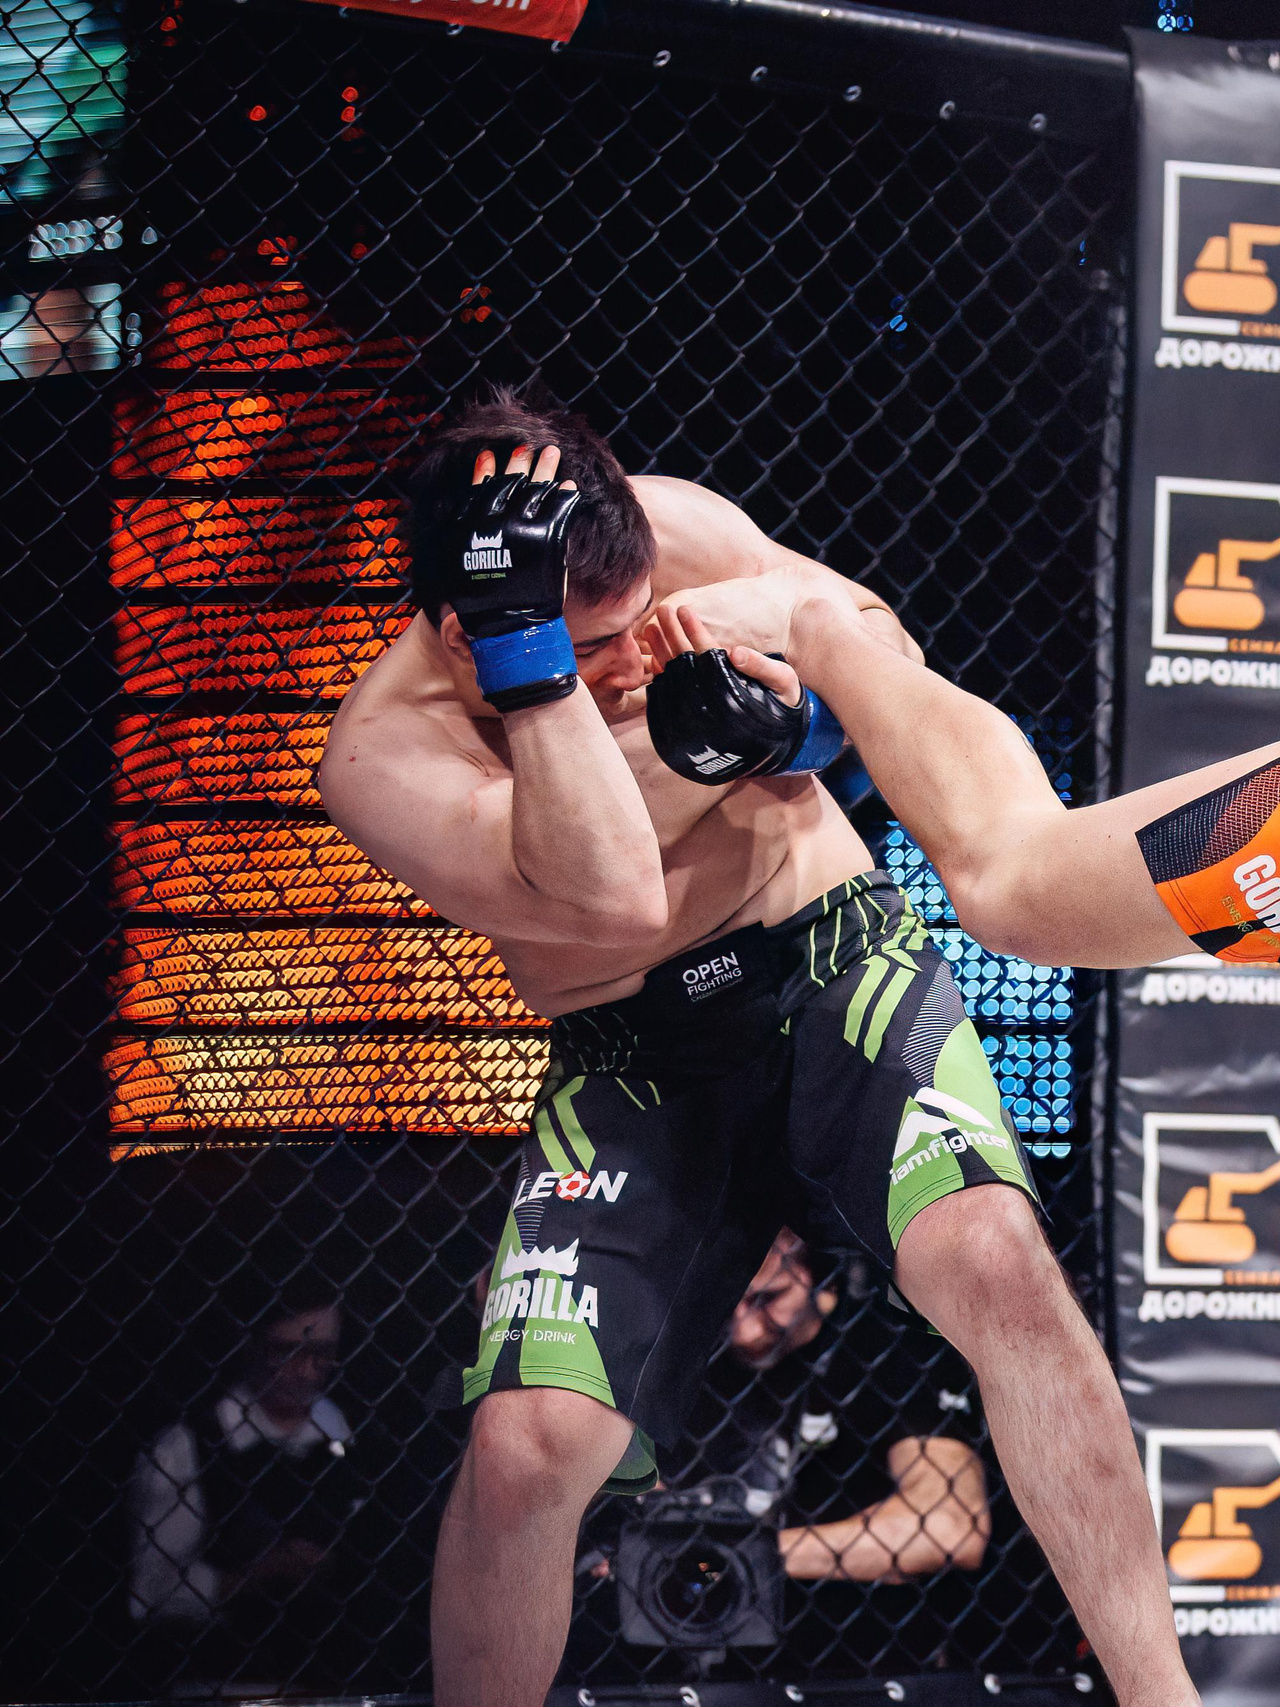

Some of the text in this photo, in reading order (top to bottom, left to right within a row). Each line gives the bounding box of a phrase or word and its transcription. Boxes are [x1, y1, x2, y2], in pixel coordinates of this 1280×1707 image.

[463, 548, 513, 571] GORILLA
[682, 951, 739, 984] OPEN
[687, 967, 742, 996] FIGHTING
[889, 1129, 1008, 1186] iamfighter
[513, 1170, 629, 1210] LEON
[481, 1278, 599, 1331] GORILLA
[487, 1328, 577, 1345] NERGY DRINK
